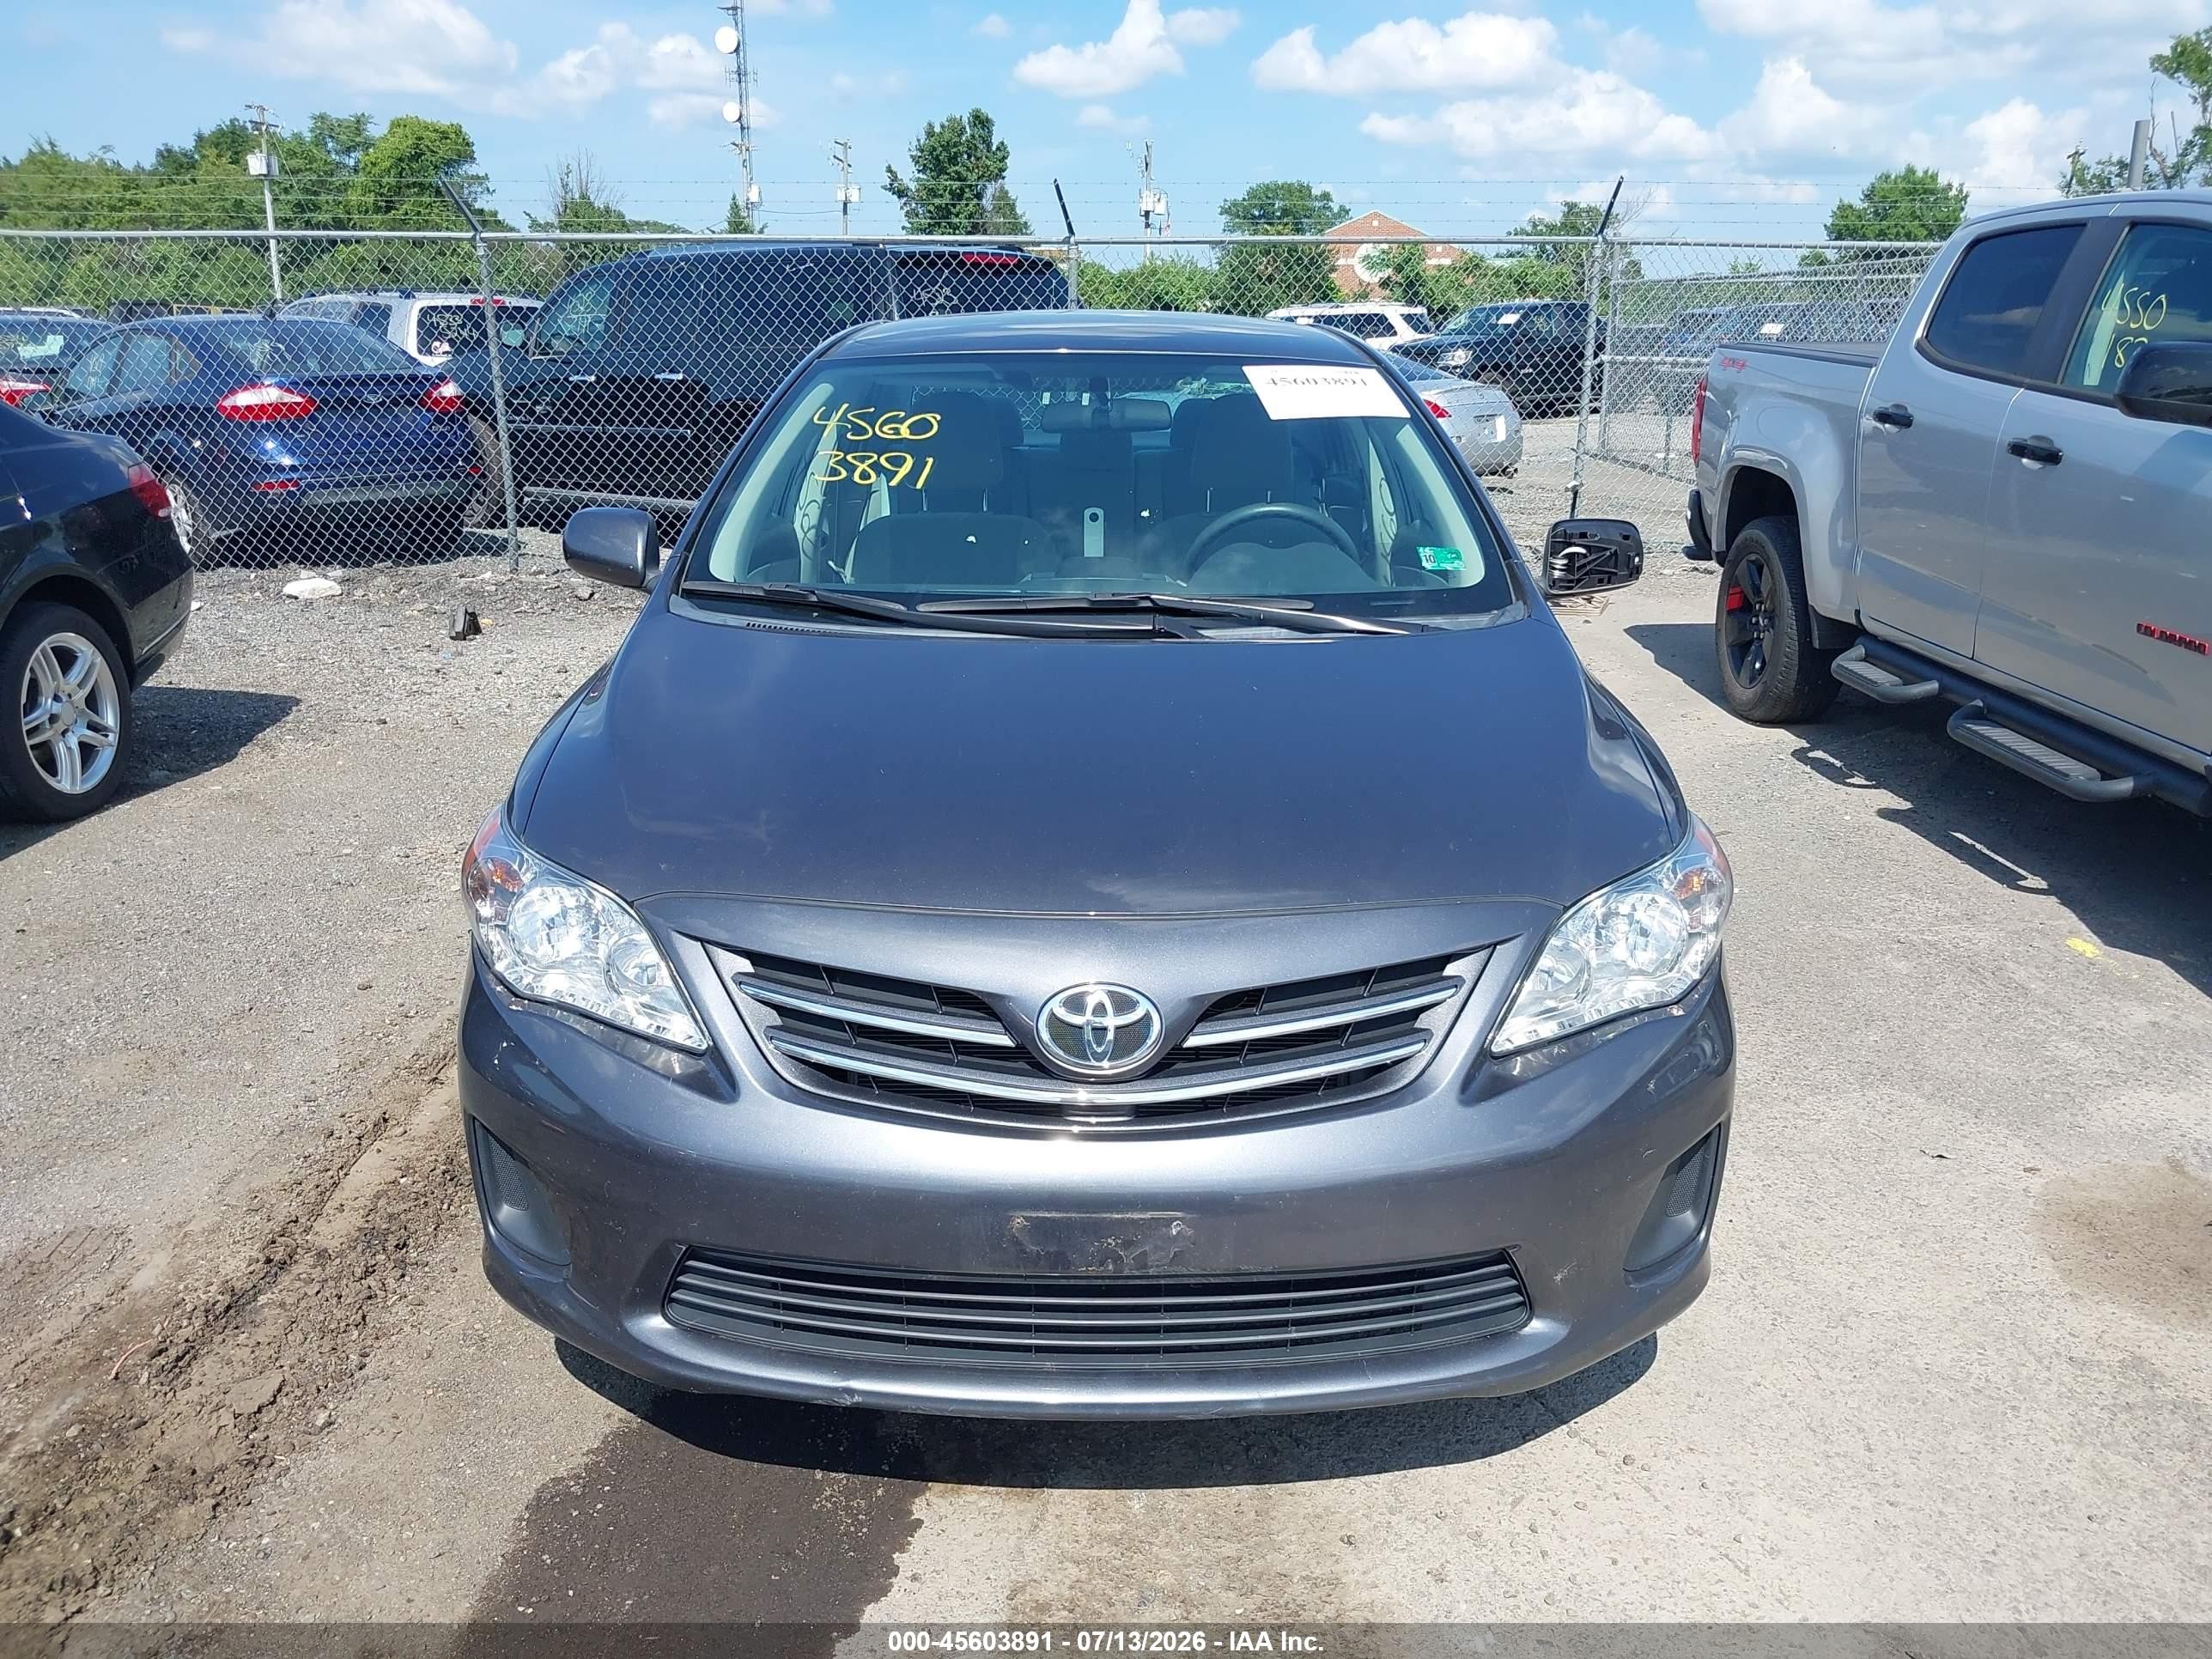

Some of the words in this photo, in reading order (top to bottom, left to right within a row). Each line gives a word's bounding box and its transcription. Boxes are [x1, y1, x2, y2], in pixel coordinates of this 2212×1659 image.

[2101, 283, 2166, 330] 4550
[2100, 332, 2148, 368] 18
[1265, 377, 1368, 388] 45603891
[812, 402, 942, 441] 4560
[812, 450, 933, 489] 3891
[1421, 554, 1437, 564] 10
